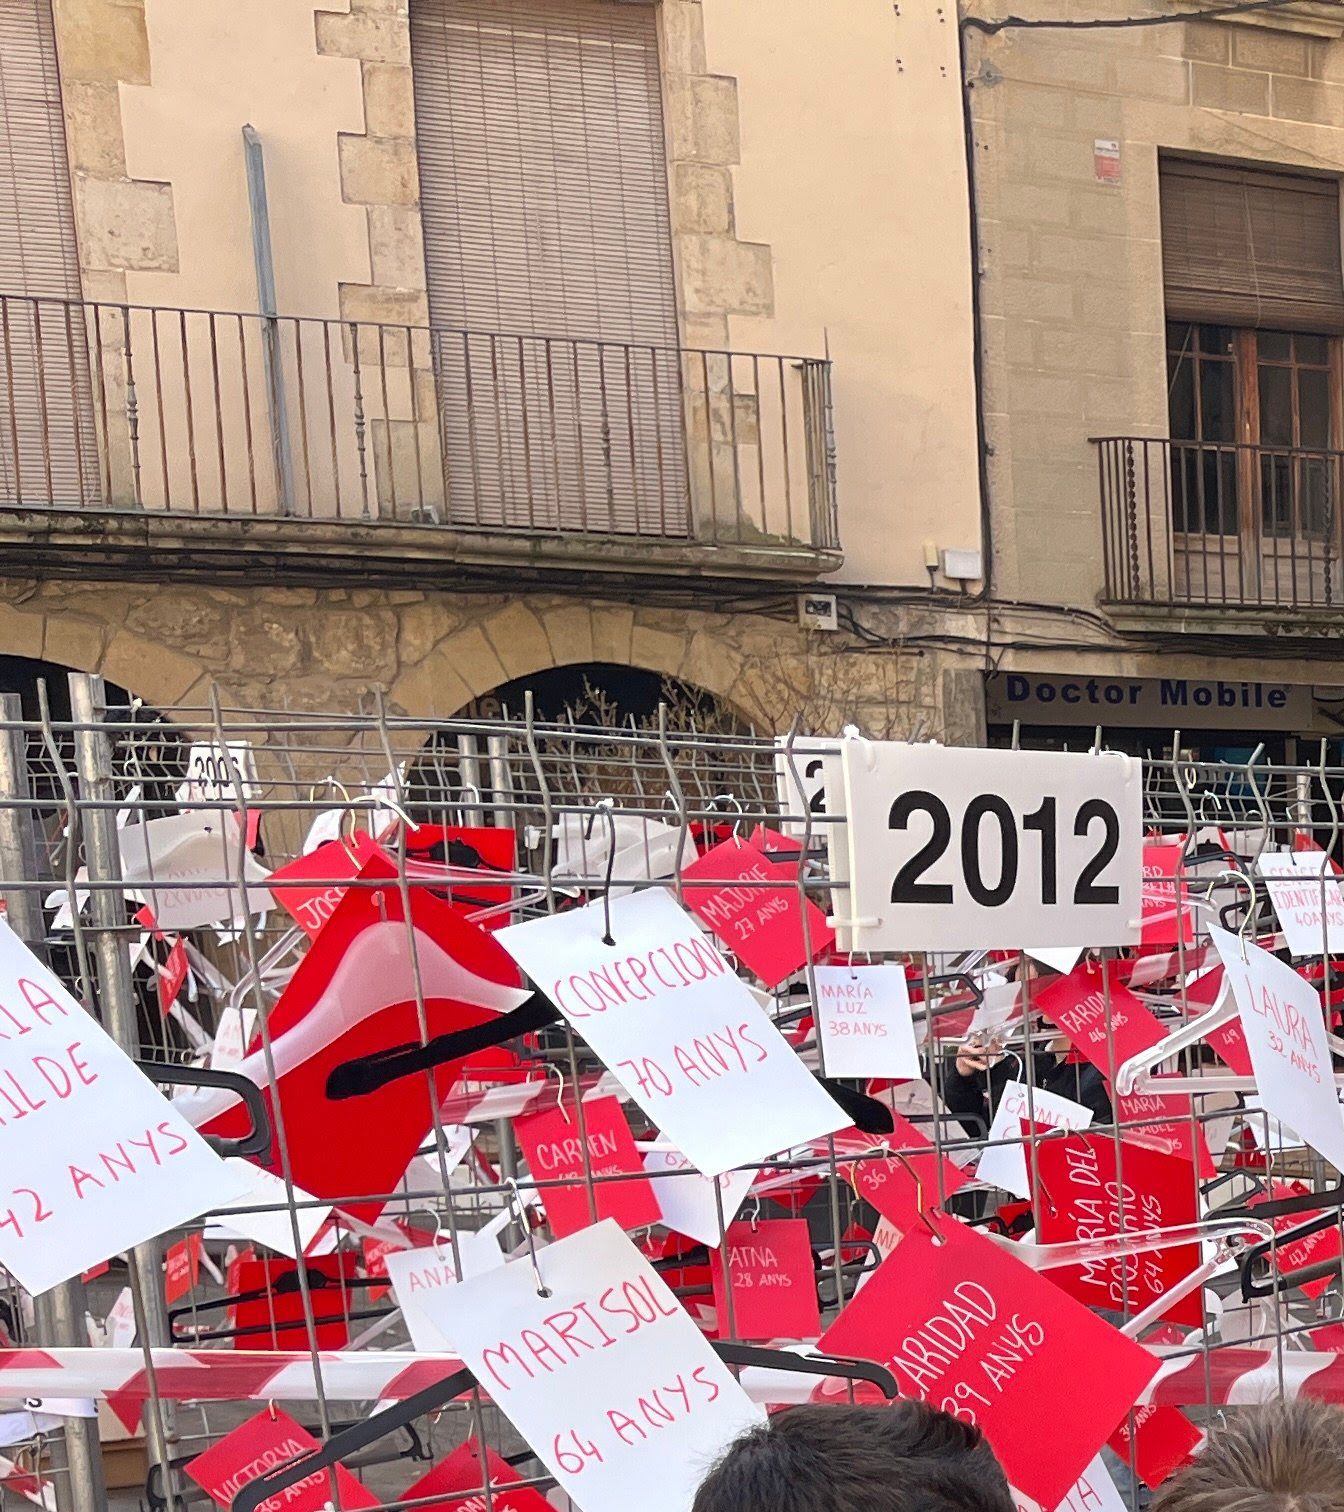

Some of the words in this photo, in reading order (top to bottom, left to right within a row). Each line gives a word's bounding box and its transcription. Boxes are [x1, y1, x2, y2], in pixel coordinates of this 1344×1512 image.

[1006, 674, 1142, 706] Doctor
[1160, 678, 1288, 709] Mobile
[888, 789, 1120, 907] 2012
[756, 896, 790, 926] ANYS
[820, 982, 874, 1000] MARÍA
[836, 1001, 868, 1015] LUZ
[1244, 973, 1318, 1060] LAURA
[616, 1061, 673, 1099] 70
[673, 1023, 768, 1086] ANYS
[1267, 1031, 1287, 1058] 32
[68, 1121, 189, 1200] ANYS
[1064, 1147, 1104, 1188] DEL
[734, 1272, 754, 1288] 28
[758, 1272, 793, 1289] ANYS
[482, 1272, 680, 1393] MARISOL
[975, 1312, 1045, 1396] ANYS
[554, 1429, 604, 1475] 64
[607, 1366, 720, 1445] ANYS
